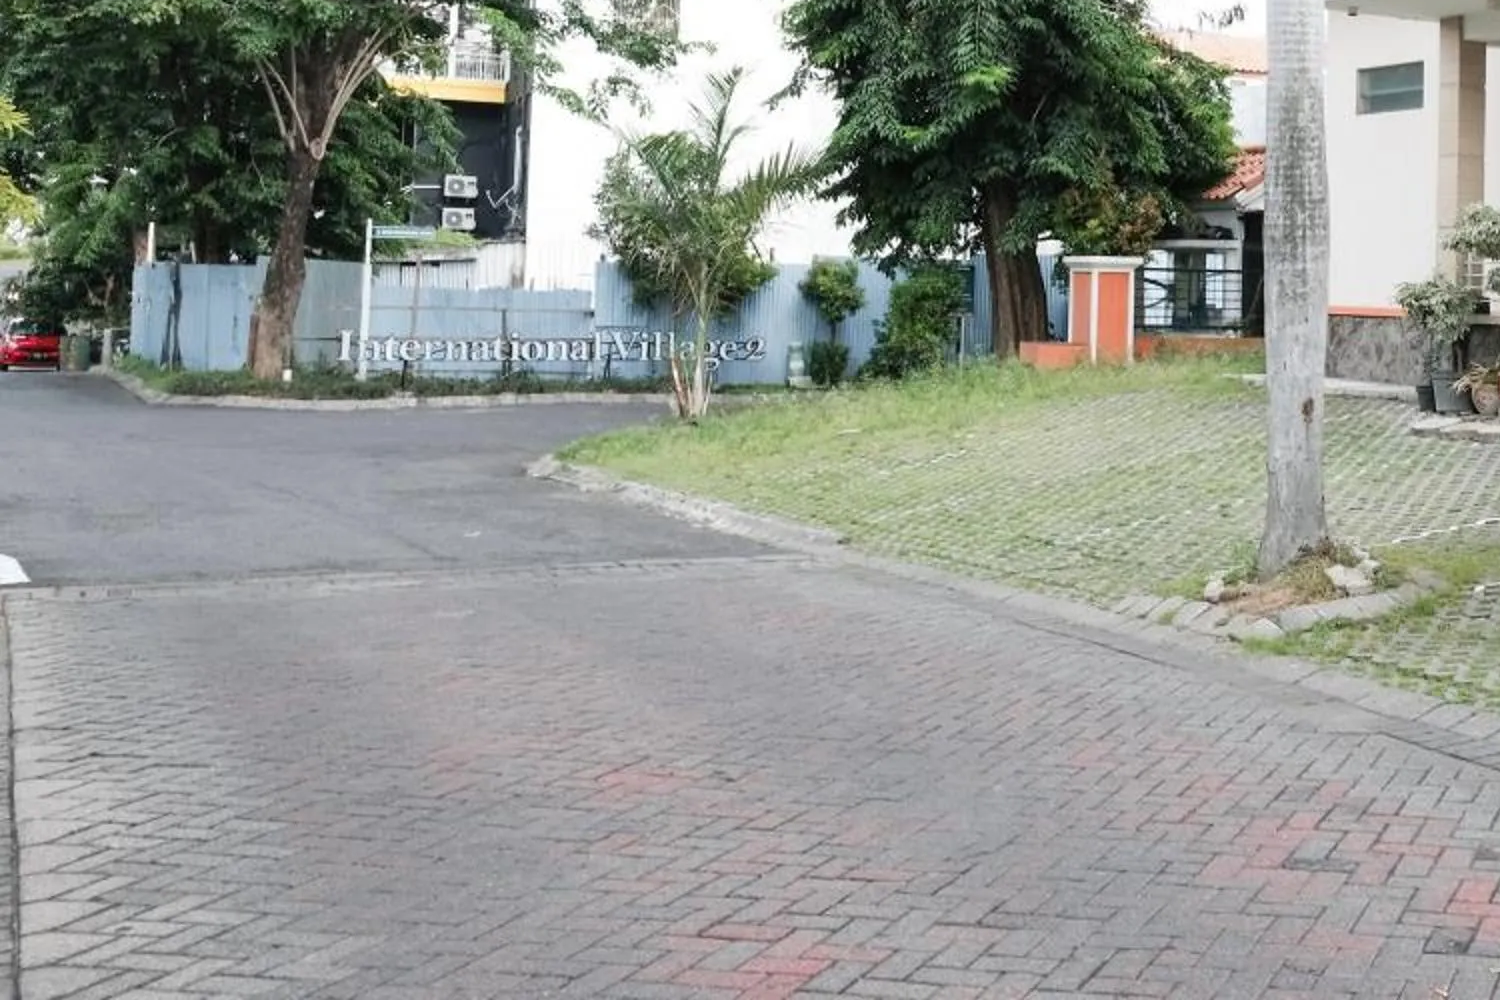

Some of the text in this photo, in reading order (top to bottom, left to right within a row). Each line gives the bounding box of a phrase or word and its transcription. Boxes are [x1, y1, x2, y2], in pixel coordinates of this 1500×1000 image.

[336, 328, 767, 372] International Village 2
